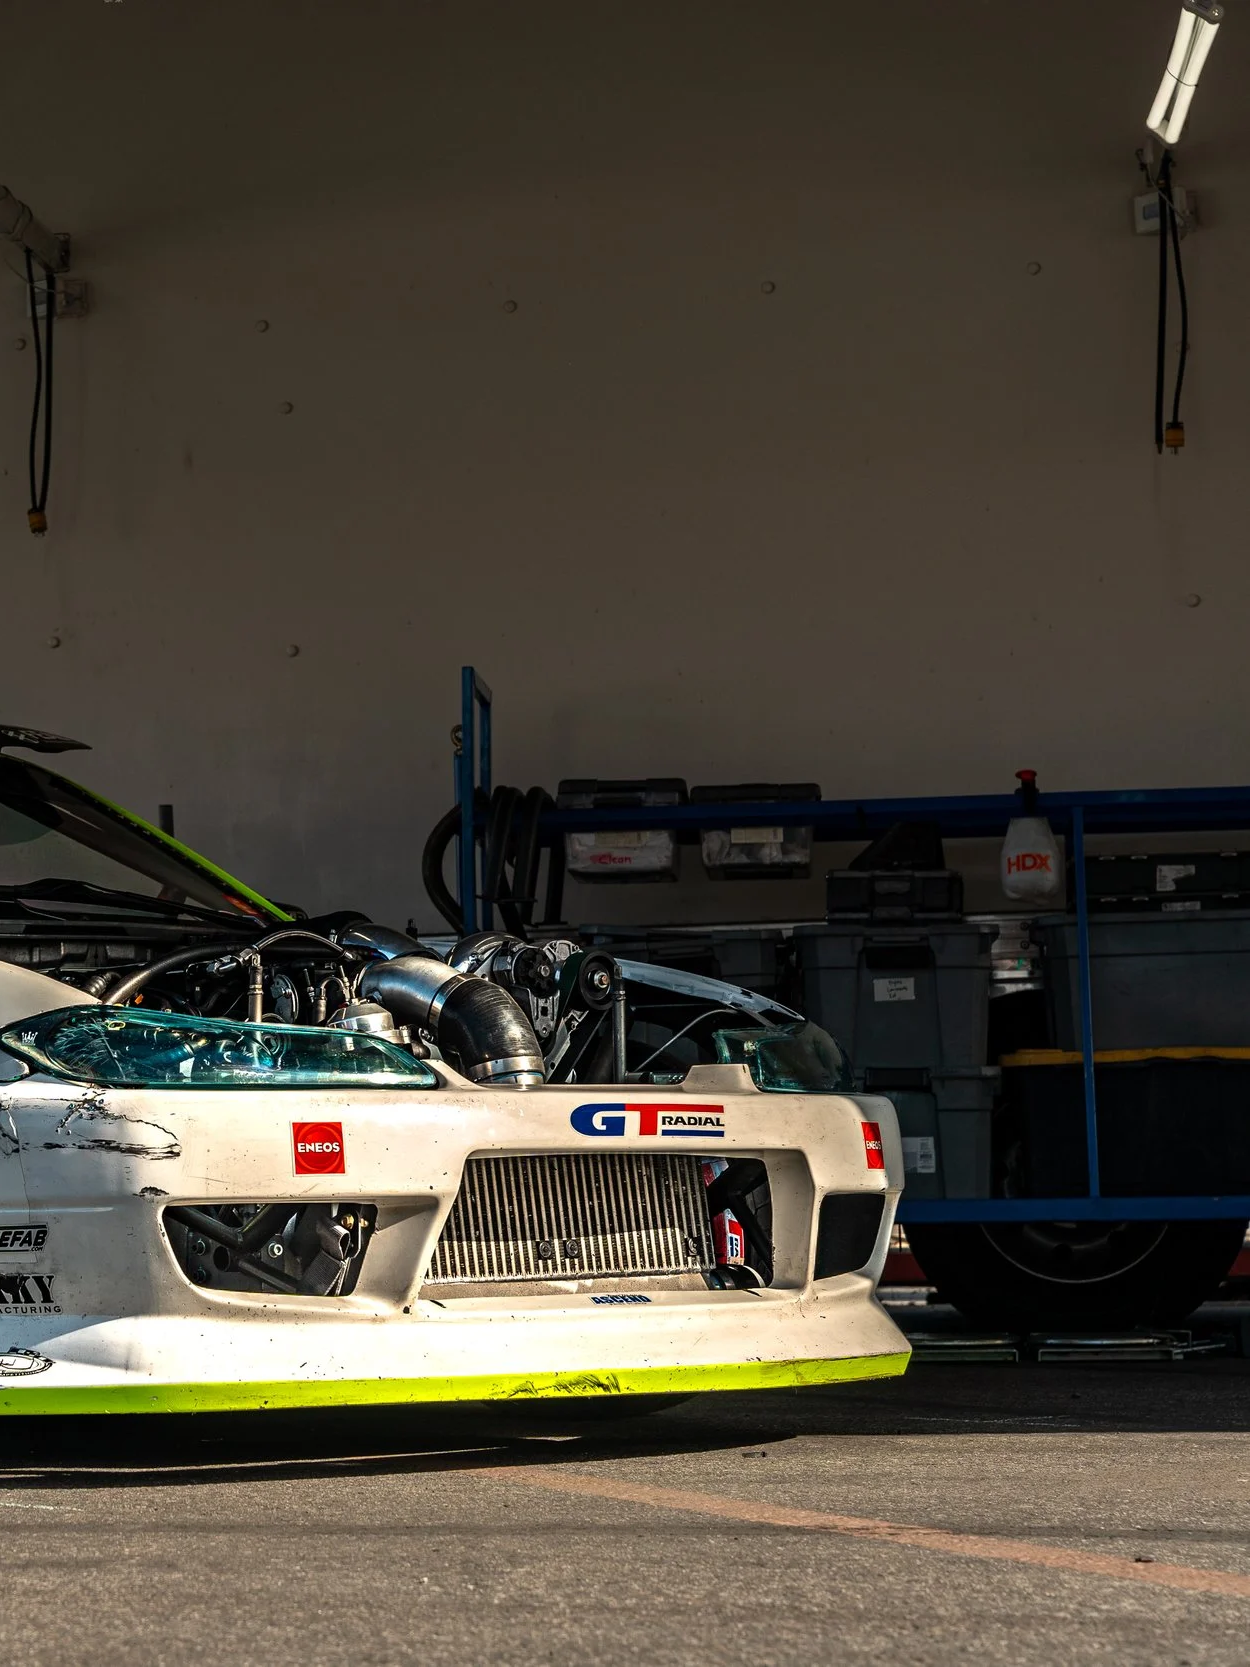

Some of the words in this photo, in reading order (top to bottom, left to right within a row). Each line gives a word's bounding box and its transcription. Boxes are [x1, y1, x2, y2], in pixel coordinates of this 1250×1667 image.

[1006, 852, 1052, 875] HDX
[570, 1103, 725, 1136] GT
[661, 1116, 725, 1127] RADIAL
[297, 1142, 340, 1153] ENEOS
[866, 1140, 882, 1150] ENEOS
